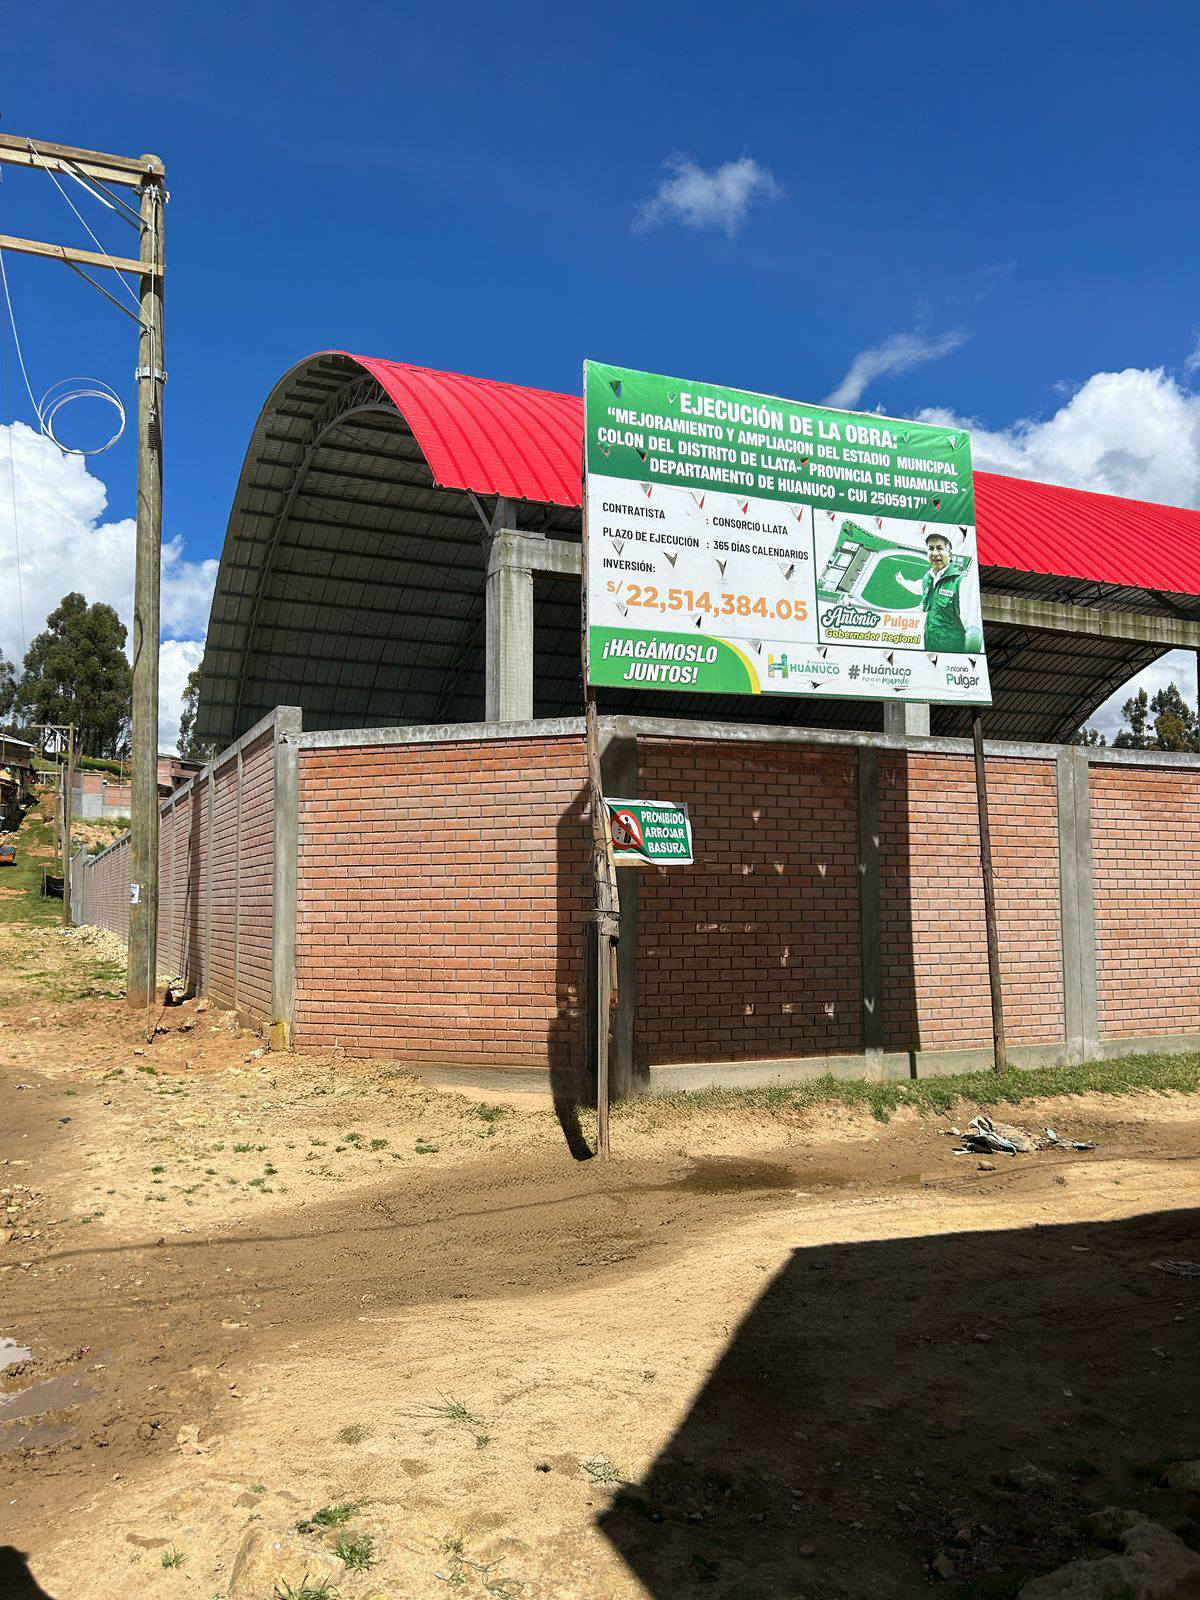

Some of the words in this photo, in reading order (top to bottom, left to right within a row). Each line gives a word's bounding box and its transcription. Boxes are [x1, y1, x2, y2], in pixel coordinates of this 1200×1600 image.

[680, 392, 784, 431] EJECUCIÓN
[790, 415, 813, 436] DE
[818, 420, 840, 441] LA
[846, 424, 898, 449] OBRA:
[598, 427, 644, 448] COLON
[648, 436, 674, 454] DEL
[678, 440, 737, 463] DISTRITO
[741, 450, 758, 467] DE
[809, 462, 872, 484] PROVINCIA
[876, 472, 891, 486] DE
[894, 475, 958, 495] HUAMALIES
[726, 428, 735, 442] Y
[738, 430, 814, 456] AMPLIACION
[818, 444, 840, 460] DEL
[843, 450, 890, 468] ESTADIO
[896, 456, 958, 476] MUNICIPAL
[650, 458, 754, 487] DEPARTAMENTO
[758, 474, 775, 490] DE
[778, 478, 836, 498] HUANUCO
[848, 488, 868, 503] CUI
[602, 502, 666, 520] CONTRATISTA
[712, 516, 761, 532] CONSORCIO
[762, 523, 788, 536] LLATA
[602, 526, 634, 540] PLAZO
[635, 531, 648, 542] DE
[650, 532, 700, 548] EJECUCIÓN
[713, 540, 730, 551] 365
[731, 542, 750, 554] DÍAS
[752, 545, 809, 560] CALENDARIOS
[603, 558, 656, 573] INVERSIÓN:
[626, 584, 808, 622] 22,514,384.05
[821, 605, 880, 628] Antonio
[883, 614, 920, 630] Pulgar
[825, 628, 880, 641] Gobernador
[881, 632, 921, 644] Regional
[602, 637, 718, 664] ¡HAGÁMOSLO
[623, 662, 698, 684] JUNTOS!
[790, 660, 840, 674] HUÁNUCO
[946, 674, 979, 688] Pulgar
[640, 810, 684, 824] PROHIBIDO
[644, 826, 685, 838] ARROJAR
[647, 842, 686, 854] BASURA
